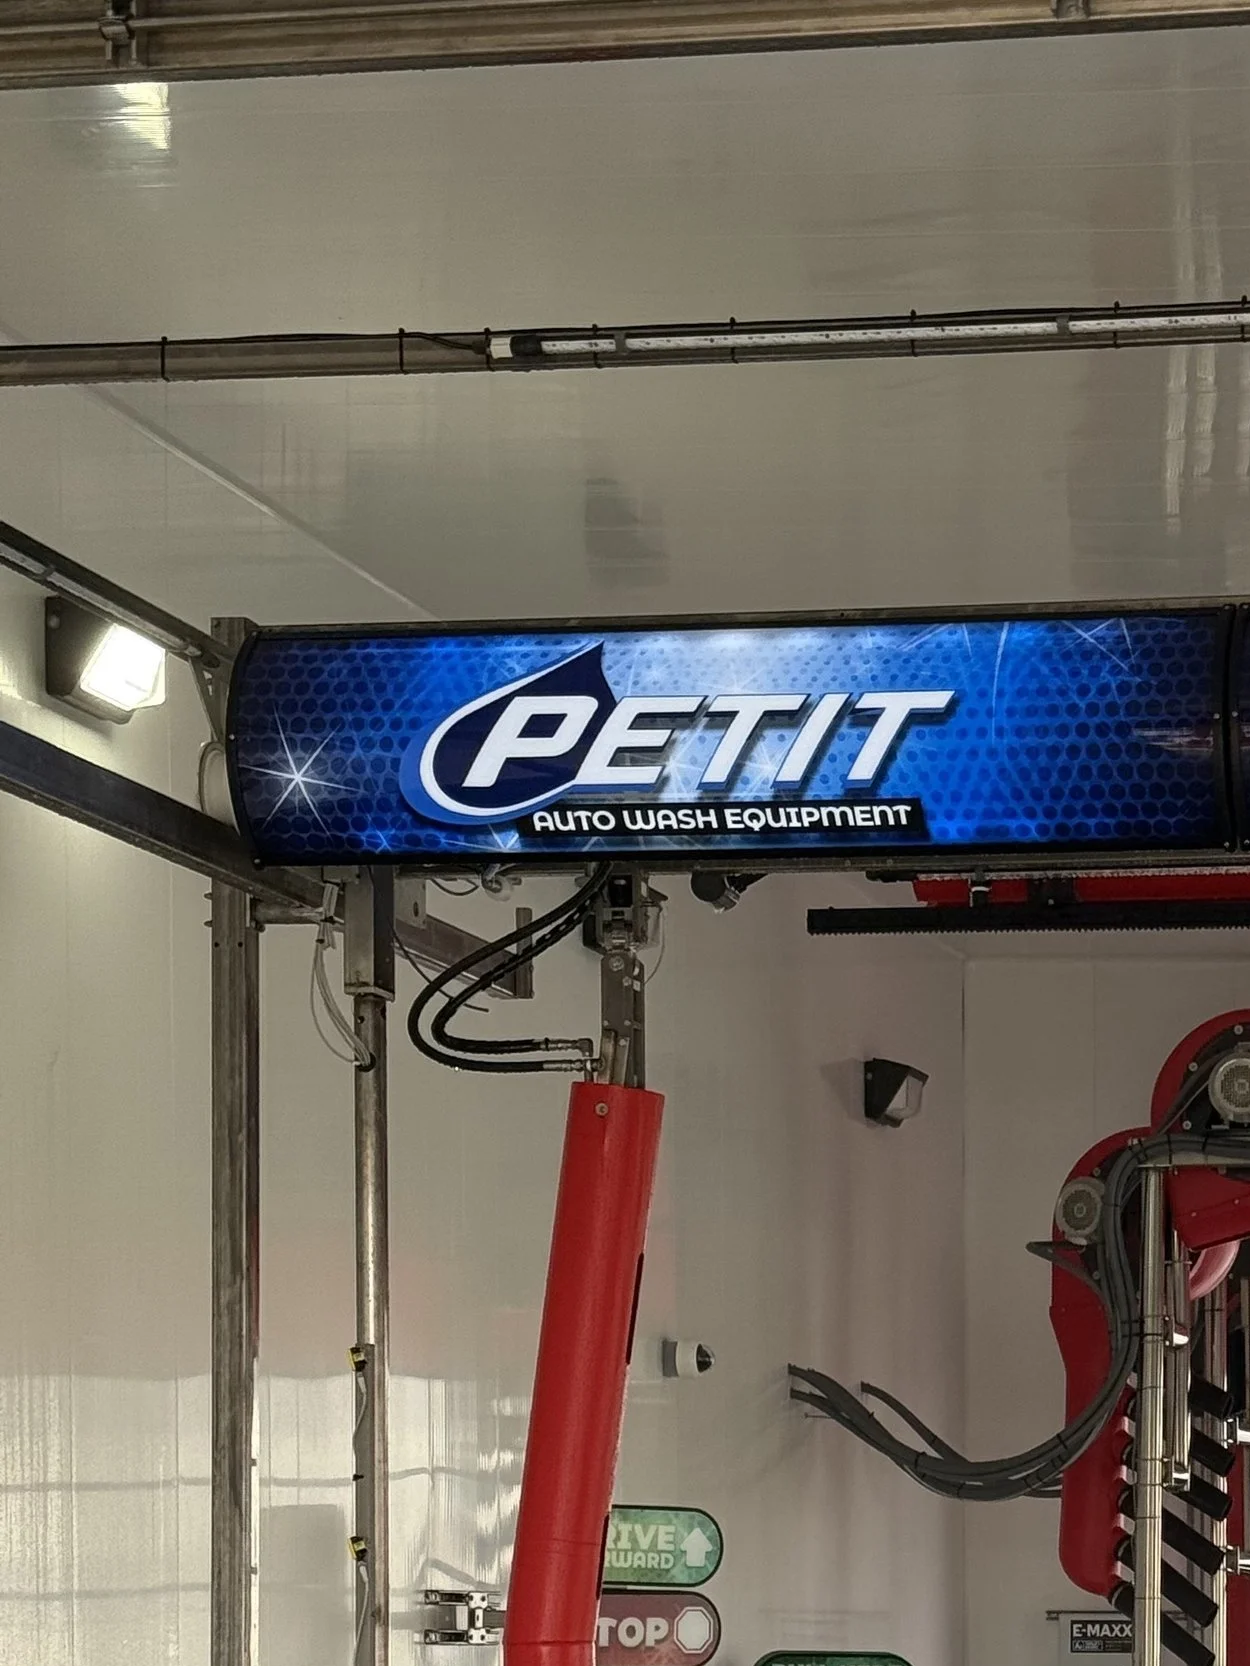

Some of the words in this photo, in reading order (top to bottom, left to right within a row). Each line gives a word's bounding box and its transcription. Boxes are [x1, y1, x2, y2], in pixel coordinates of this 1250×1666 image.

[461, 690, 956, 788] PETIT
[533, 809, 617, 832] AUTO
[623, 808, 718, 830] WASH
[725, 804, 912, 832] EQUIPMENT
[608, 1523, 677, 1551] IVE
[605, 1550, 674, 1569] WARD
[597, 1616, 669, 1648] TOP
[1072, 1623, 1133, 1637] E-MAXX
